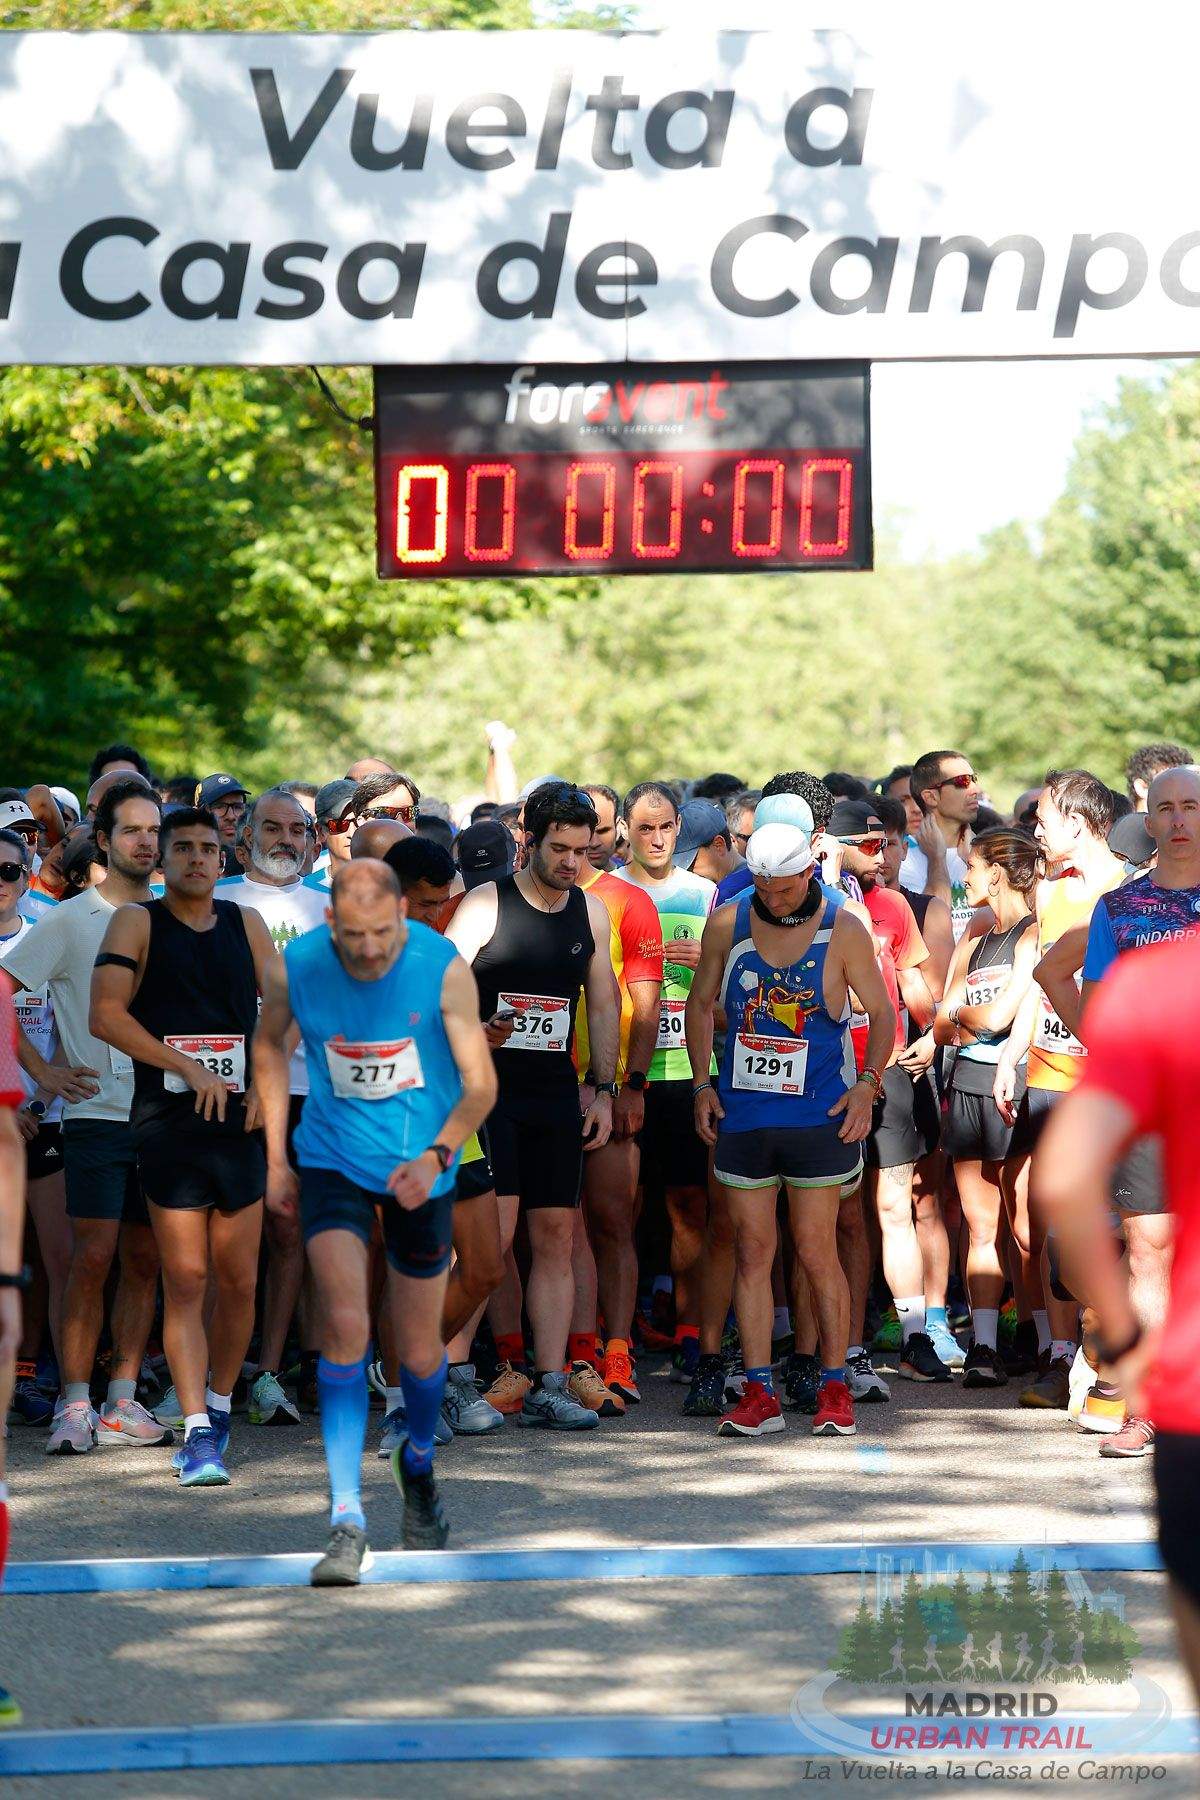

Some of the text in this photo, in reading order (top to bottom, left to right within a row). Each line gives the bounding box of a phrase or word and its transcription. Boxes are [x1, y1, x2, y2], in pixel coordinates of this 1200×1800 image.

[249, 67, 875, 172] Vuelta a
[58, 215, 427, 321] Casa
[475, 213, 661, 320] de
[504, 365, 730, 425] forevent
[512, 1015, 553, 1035] 376
[1044, 1018, 1071, 1039] 945
[351, 1063, 396, 1082] 277
[744, 1056, 794, 1078] 1291
